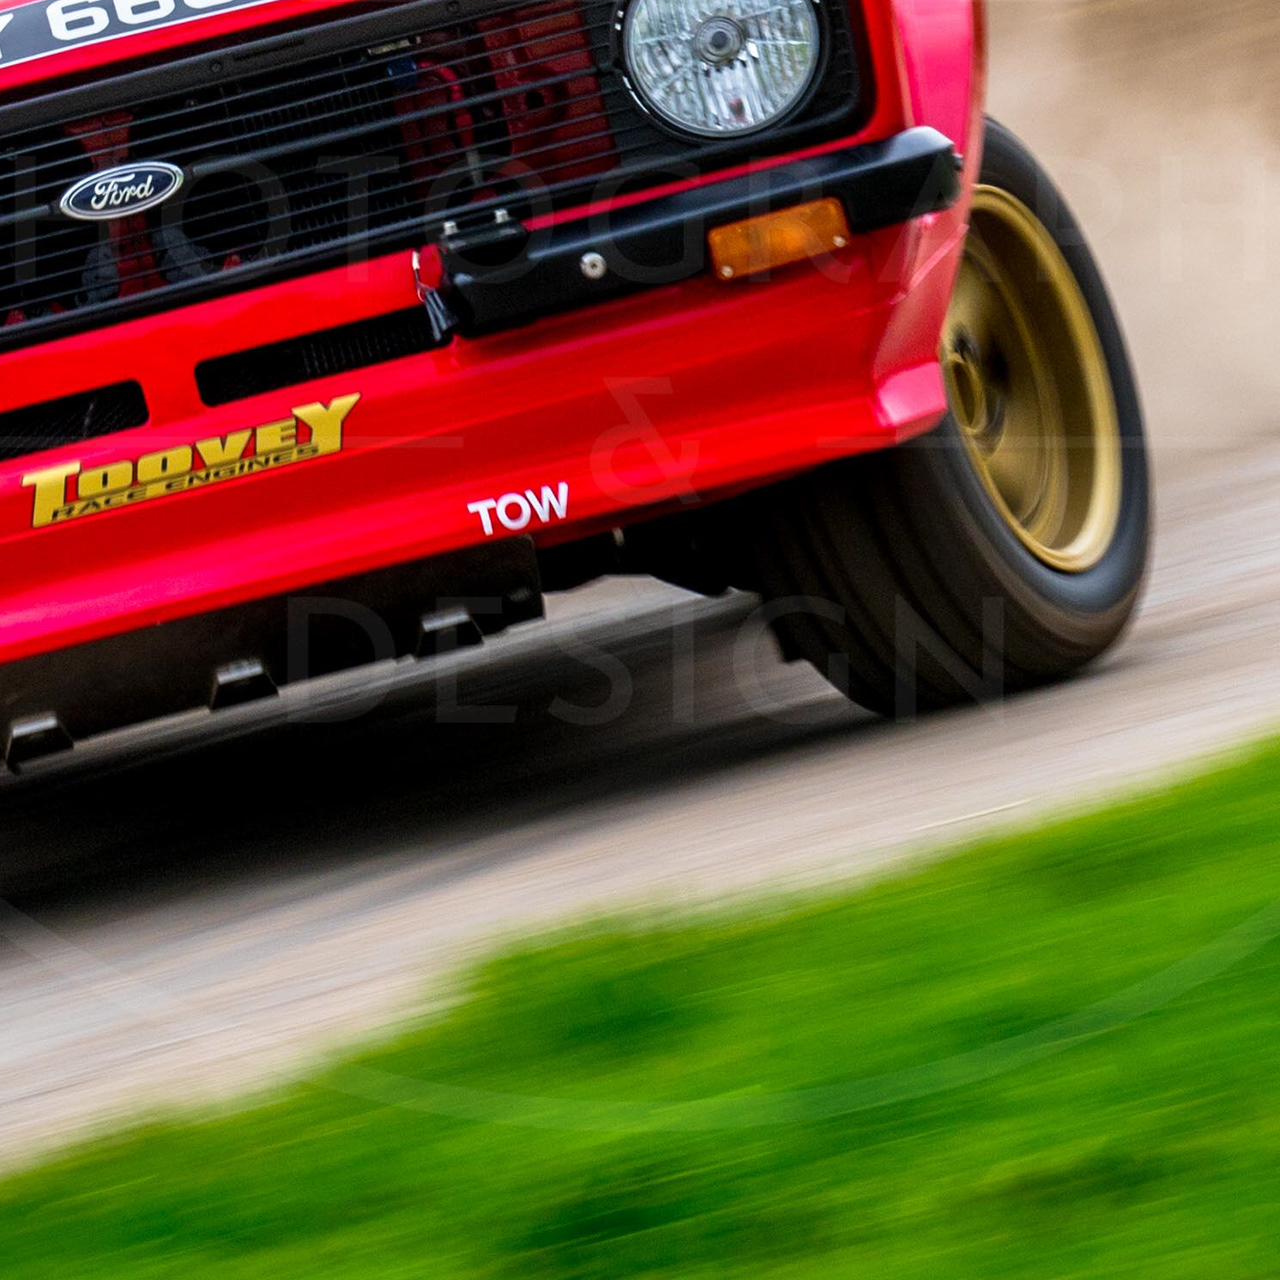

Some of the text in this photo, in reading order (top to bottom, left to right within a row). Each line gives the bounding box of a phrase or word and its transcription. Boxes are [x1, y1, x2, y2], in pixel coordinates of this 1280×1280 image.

[90, 172, 155, 210] Ford
[22, 391, 362, 528] TOOVEY
[51, 443, 320, 522] RACE ENGINES
[466, 480, 569, 536] TOW
